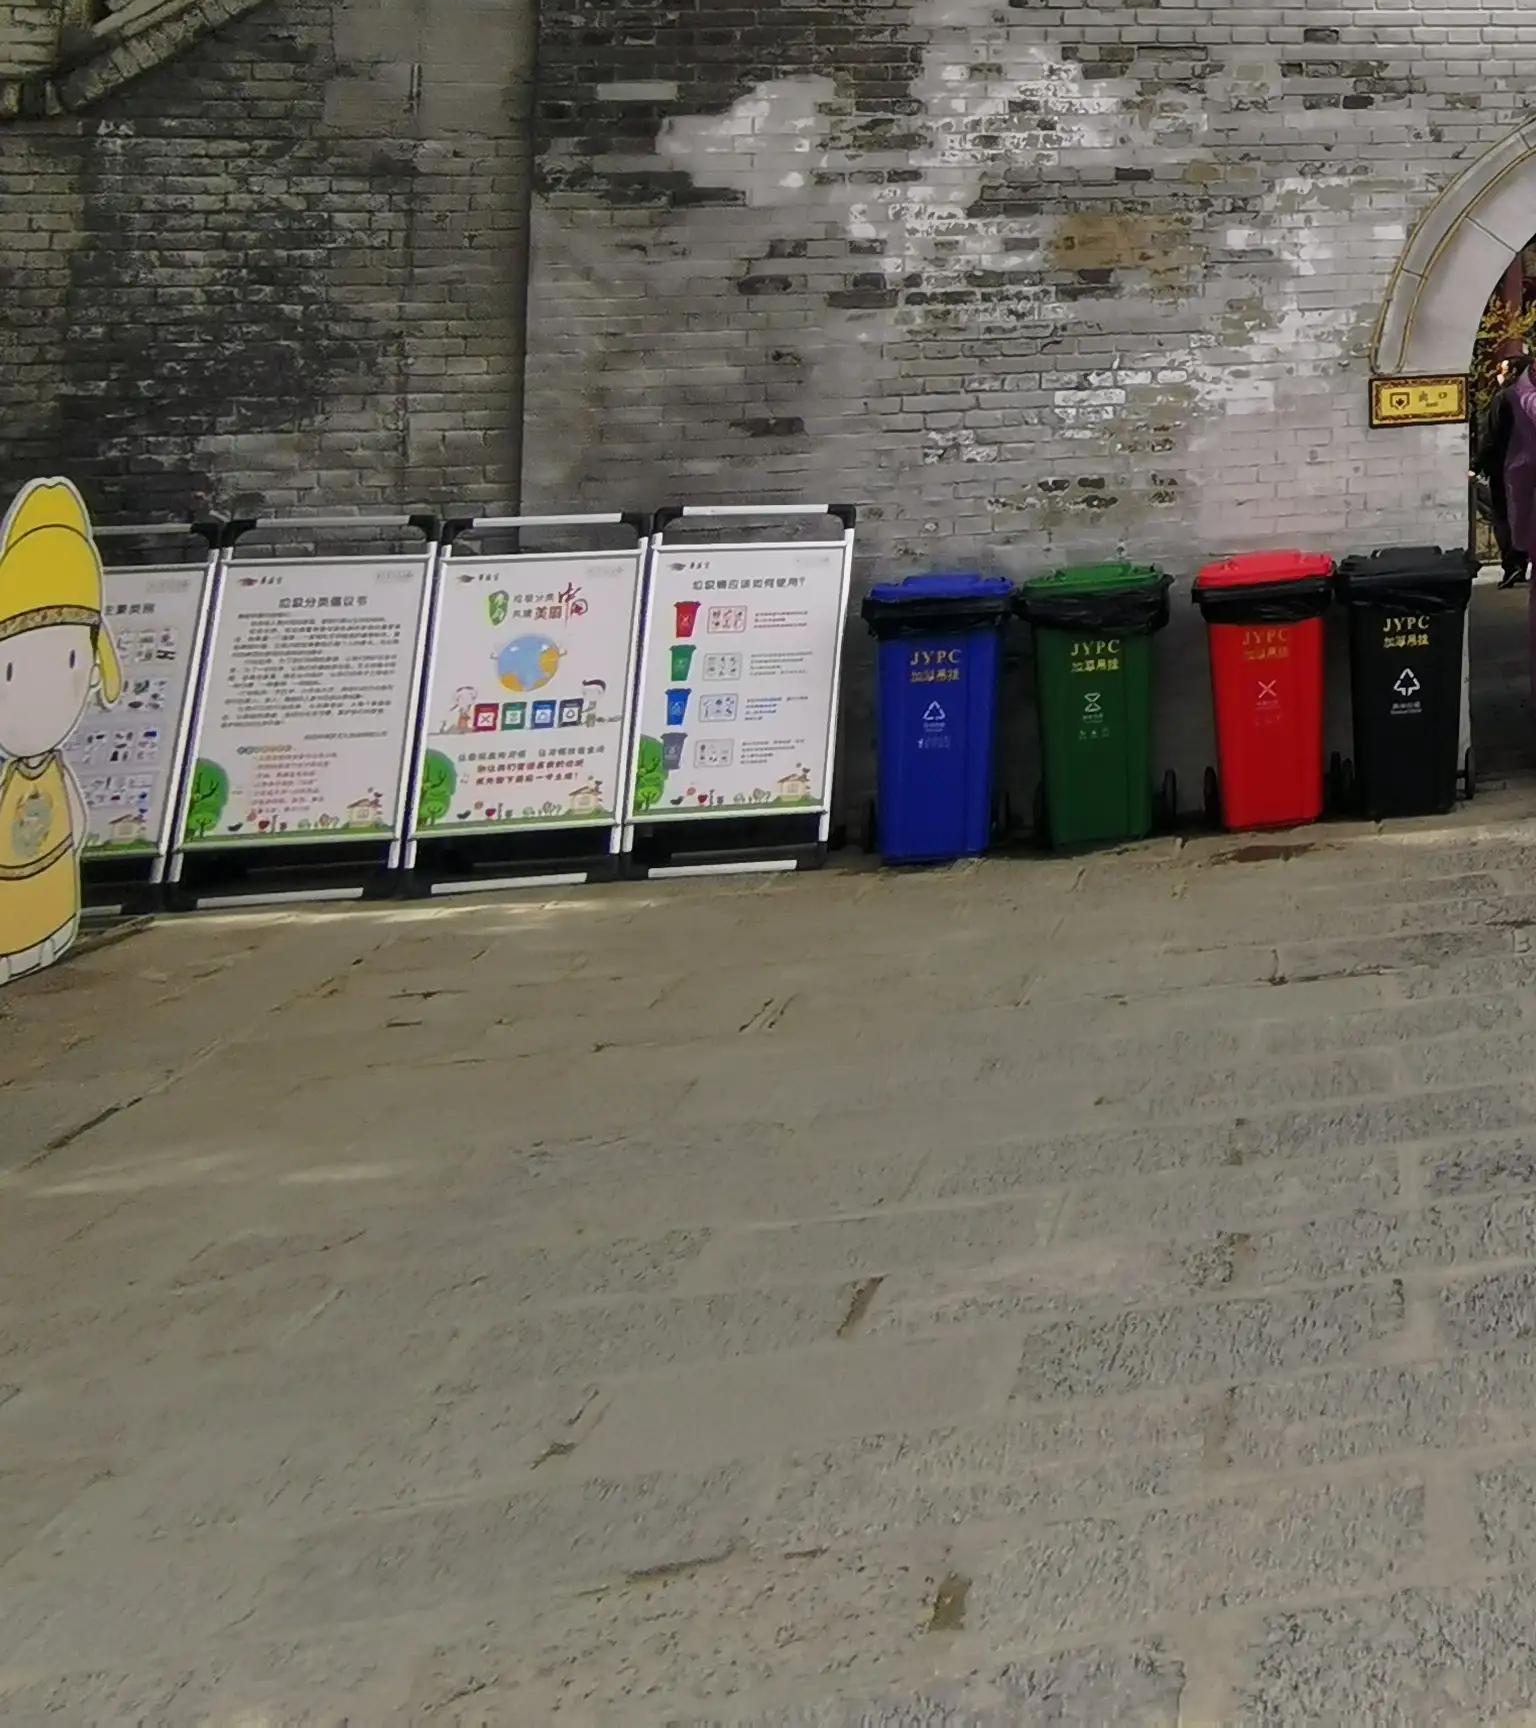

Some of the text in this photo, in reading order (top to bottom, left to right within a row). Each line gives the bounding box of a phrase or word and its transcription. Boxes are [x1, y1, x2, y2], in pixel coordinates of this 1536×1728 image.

[1382, 615, 1430, 632] JYPC
[1242, 629, 1289, 646] JYPC
[1070, 639, 1120, 656] JYPC
[910, 649, 962, 666] JYPC
